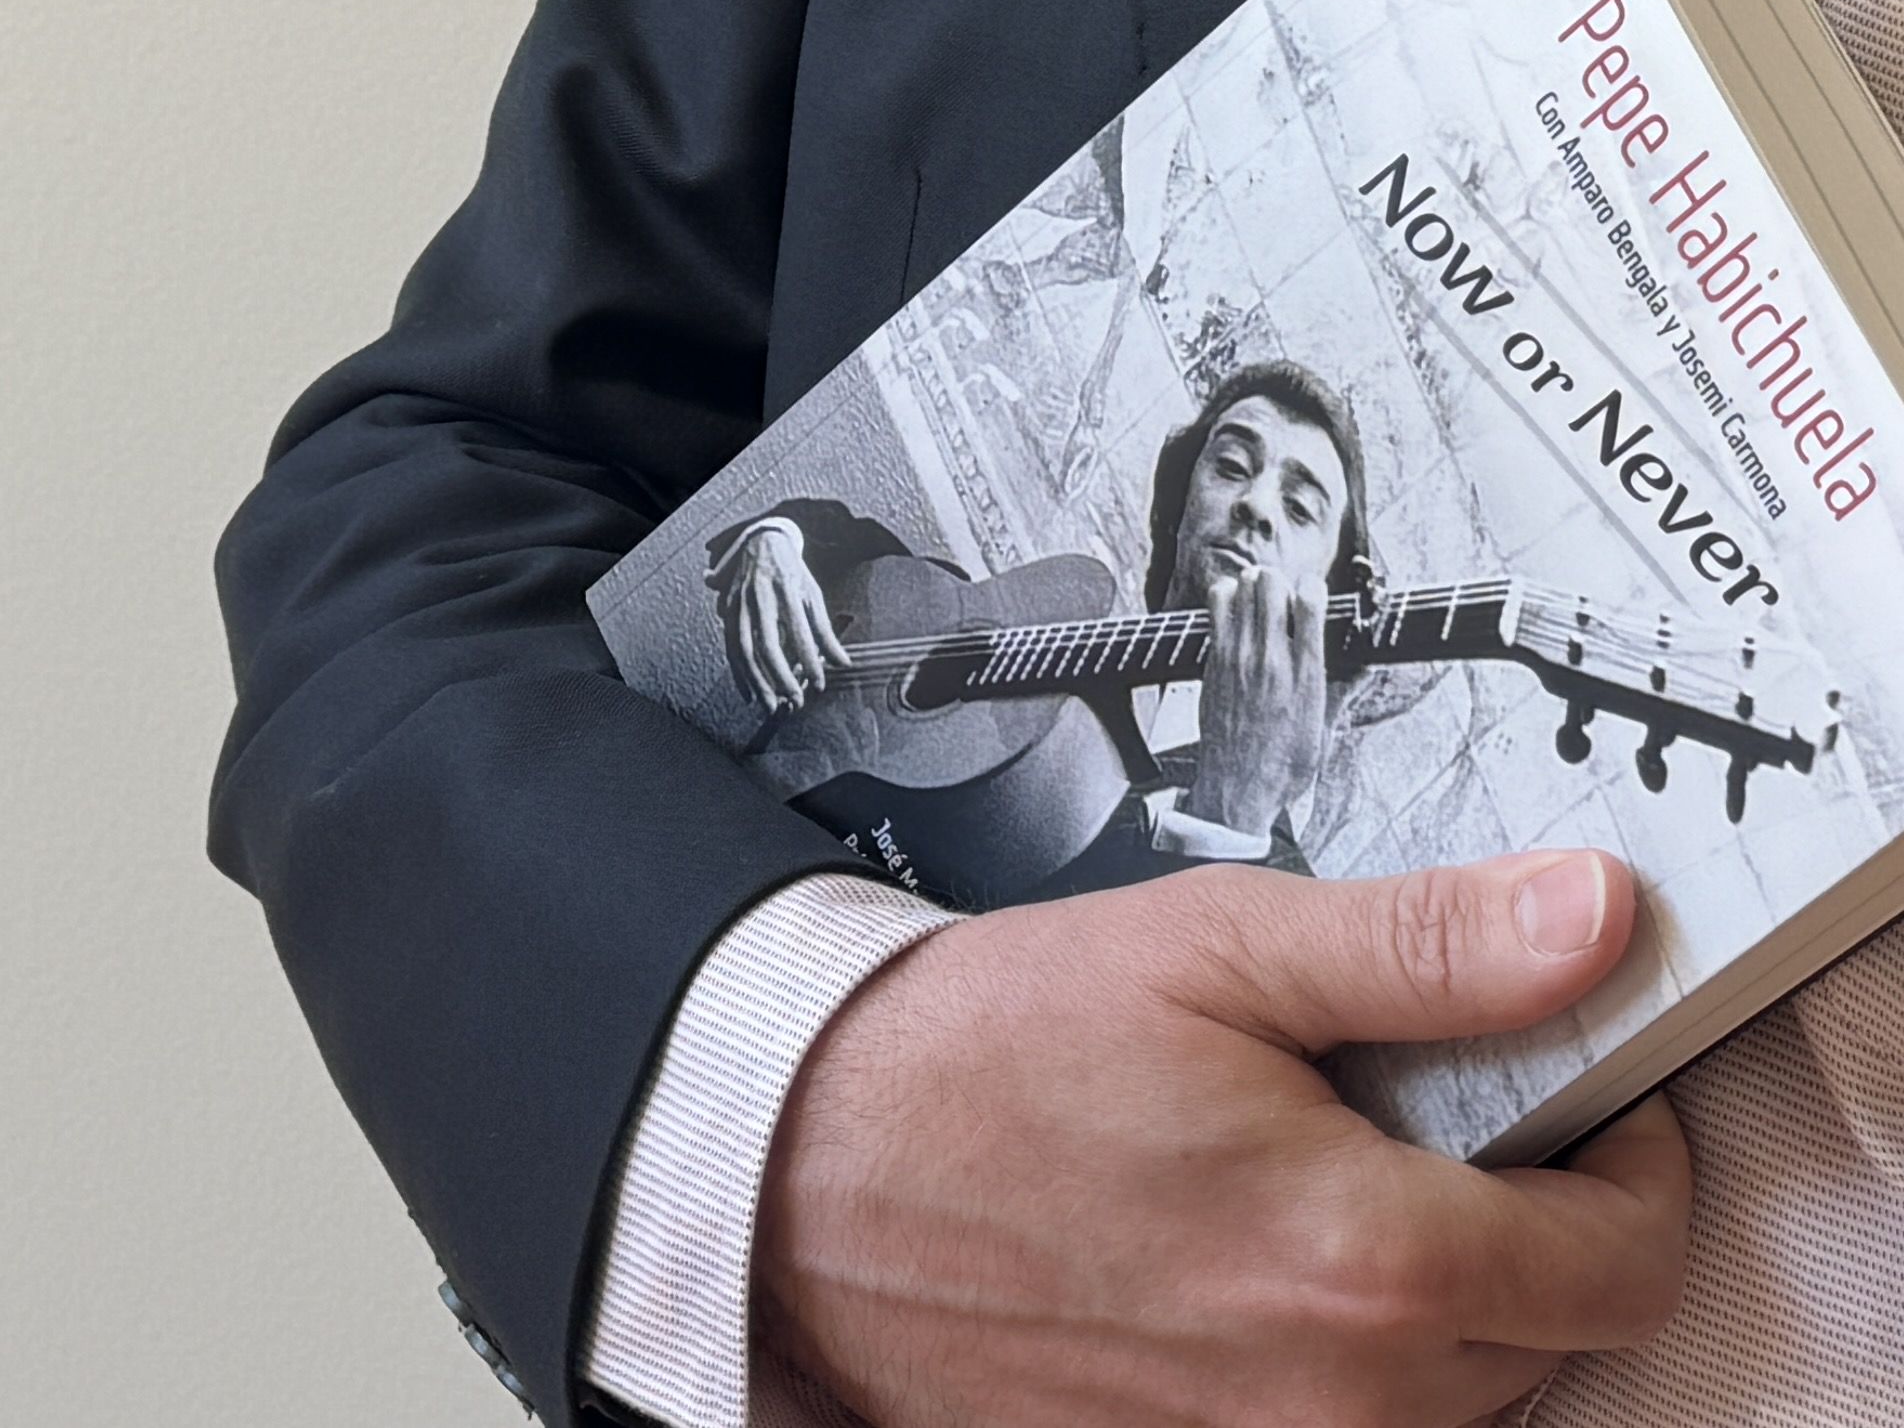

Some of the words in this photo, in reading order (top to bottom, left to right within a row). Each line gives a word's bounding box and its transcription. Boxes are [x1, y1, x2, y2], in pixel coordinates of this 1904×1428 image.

[1358, 152, 1515, 316] Now
[1502, 331, 1574, 393] or
[1567, 389, 1780, 606] Never
[1534, 91, 1566, 141] Con
[1556, 137, 1614, 225] Amparo
[1607, 220, 1669, 318] Bengala
[1656, 304, 1681, 337] y
[1671, 328, 1734, 417] Josemi
[1720, 412, 1787, 521] Carmona
[1648, 150, 1877, 522] Habichuela
[871, 817, 909, 872] José
